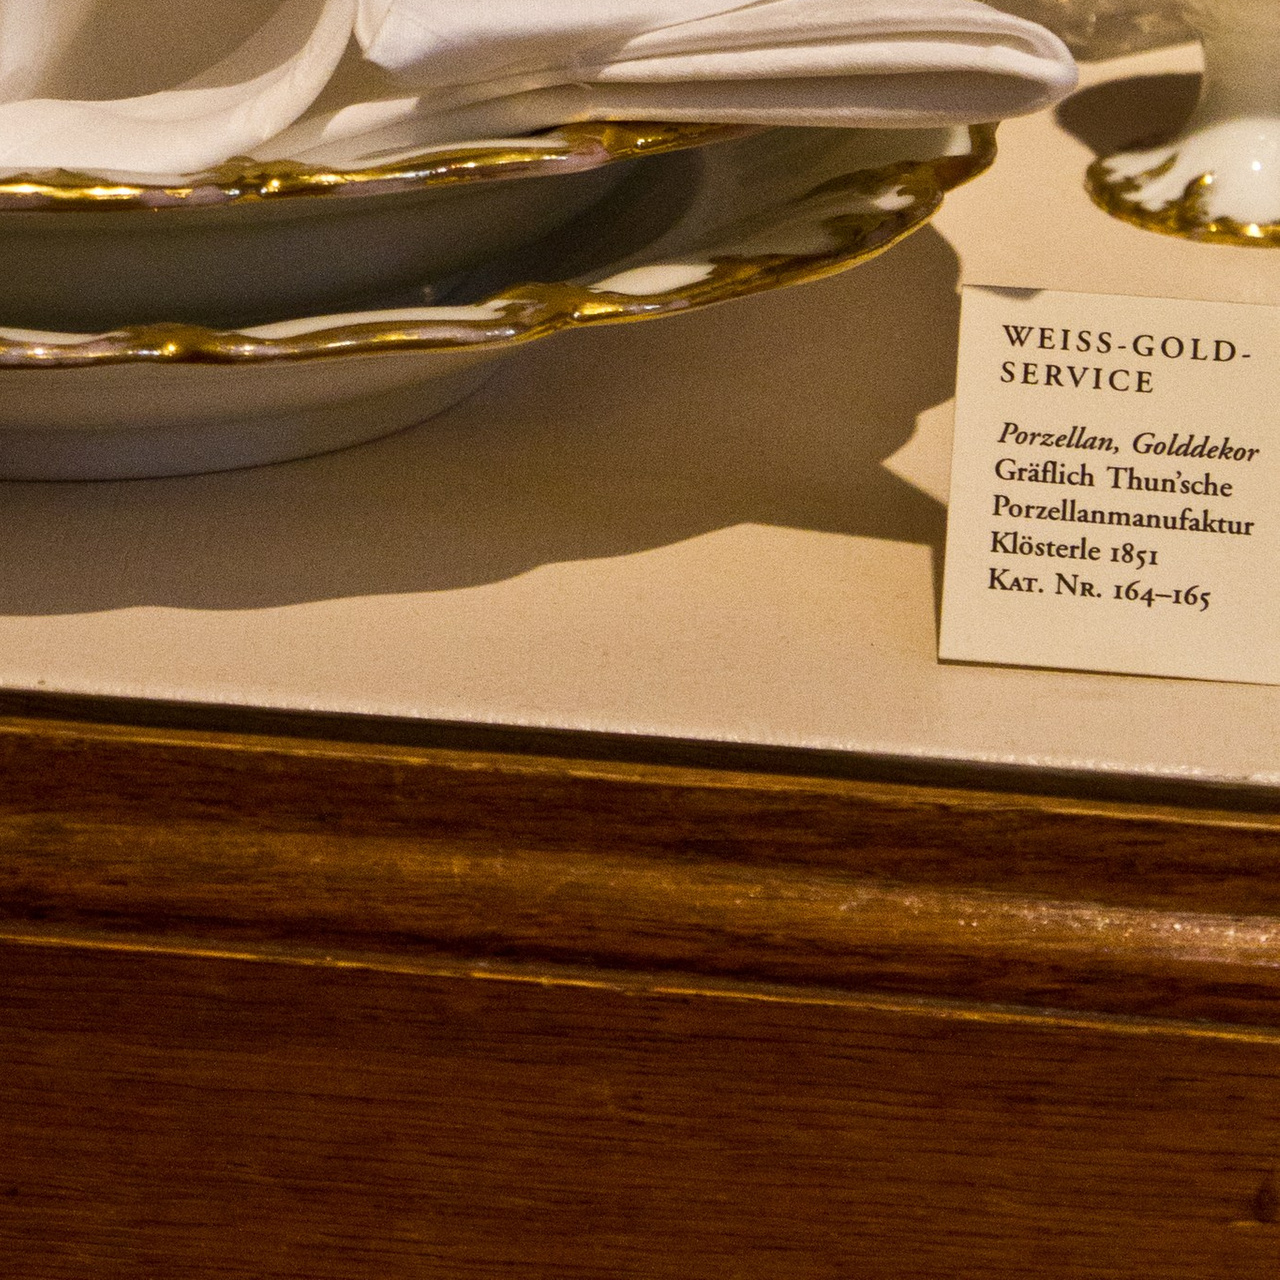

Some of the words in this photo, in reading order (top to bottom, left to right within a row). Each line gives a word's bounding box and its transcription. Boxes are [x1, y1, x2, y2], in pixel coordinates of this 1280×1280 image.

[1003, 325, 1250, 362] WEISS-GOLD-
[1000, 361, 1153, 393] SERVICE
[997, 422, 1119, 454] Porzellan,
[1133, 432, 1260, 461] Golddekor
[995, 458, 1094, 487] Gräflich
[993, 494, 1254, 535] Porzellanmanufaktur
[991, 531, 1100, 561] Klösterle
[1111, 543, 1157, 570] 1851
